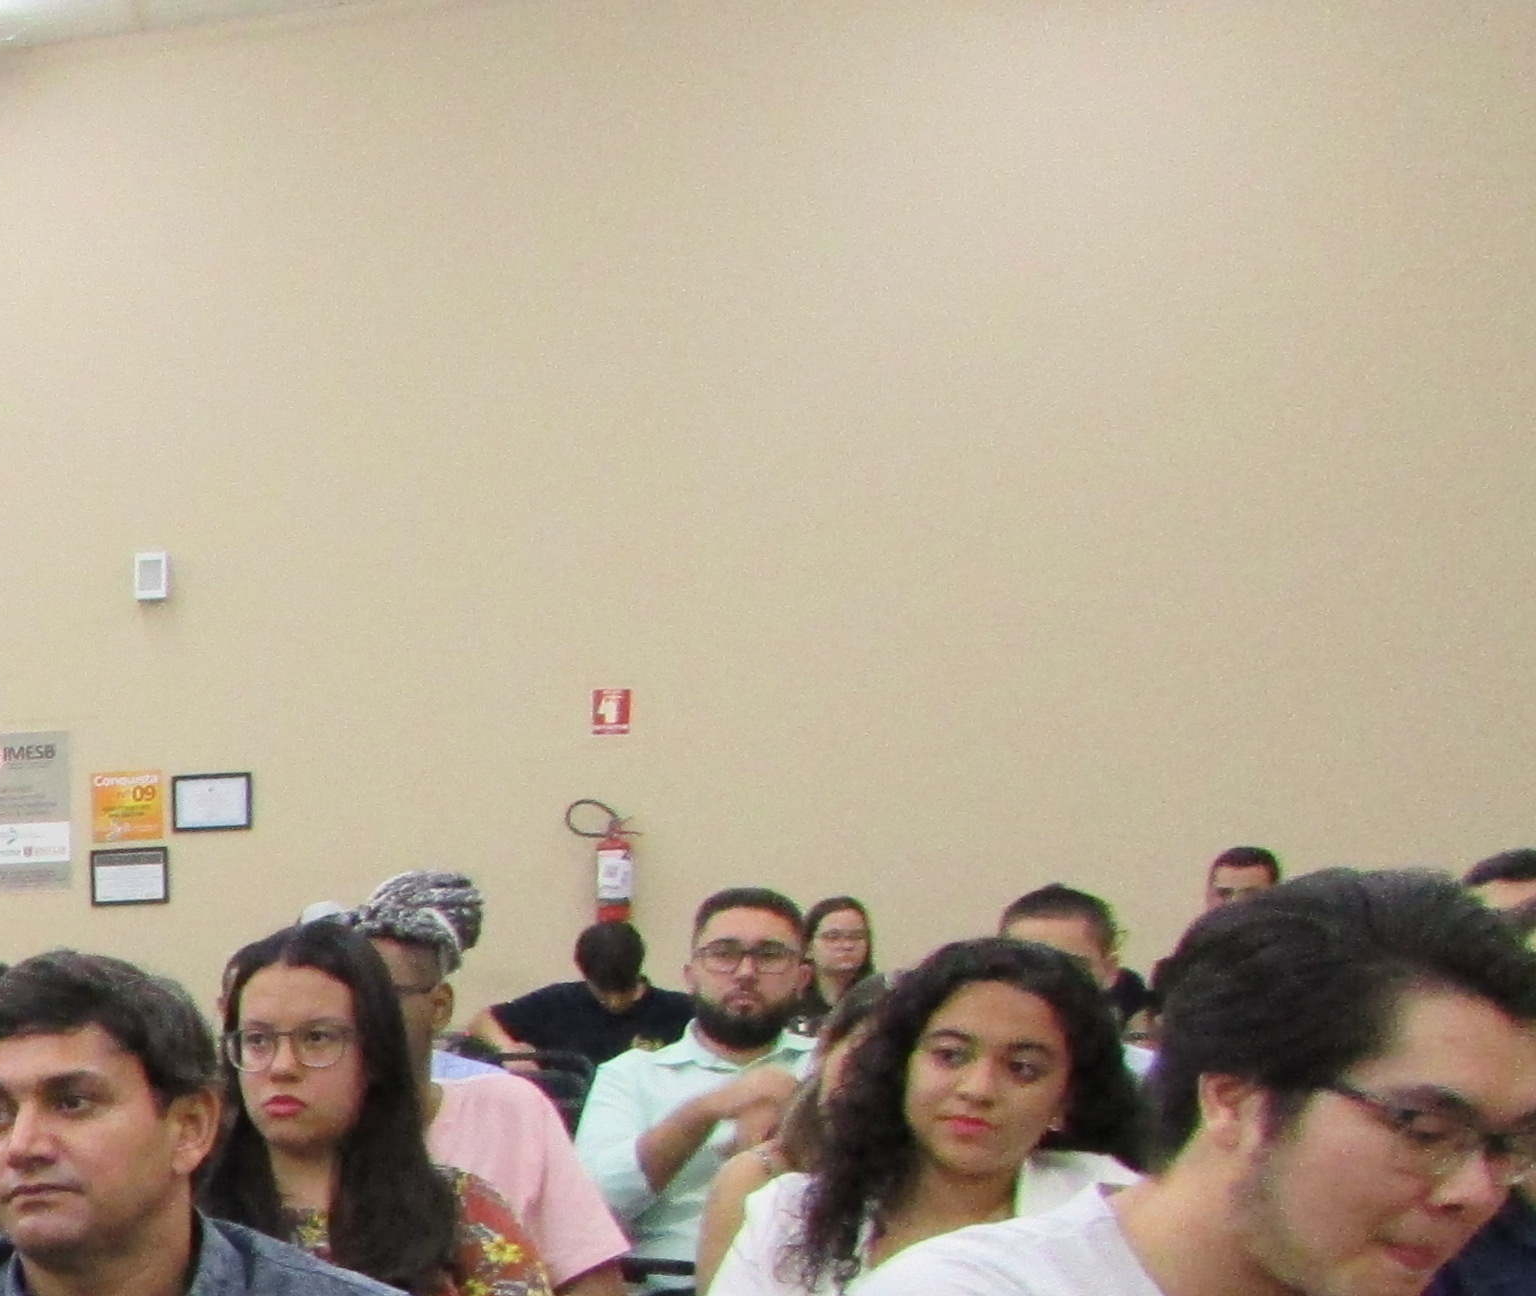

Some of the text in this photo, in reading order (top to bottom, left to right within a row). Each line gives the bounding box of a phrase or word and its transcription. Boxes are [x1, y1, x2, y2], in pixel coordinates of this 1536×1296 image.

[3, 745, 56, 761] IMESB
[94, 773, 160, 787] Conquista
[132, 785, 156, 801] 09
